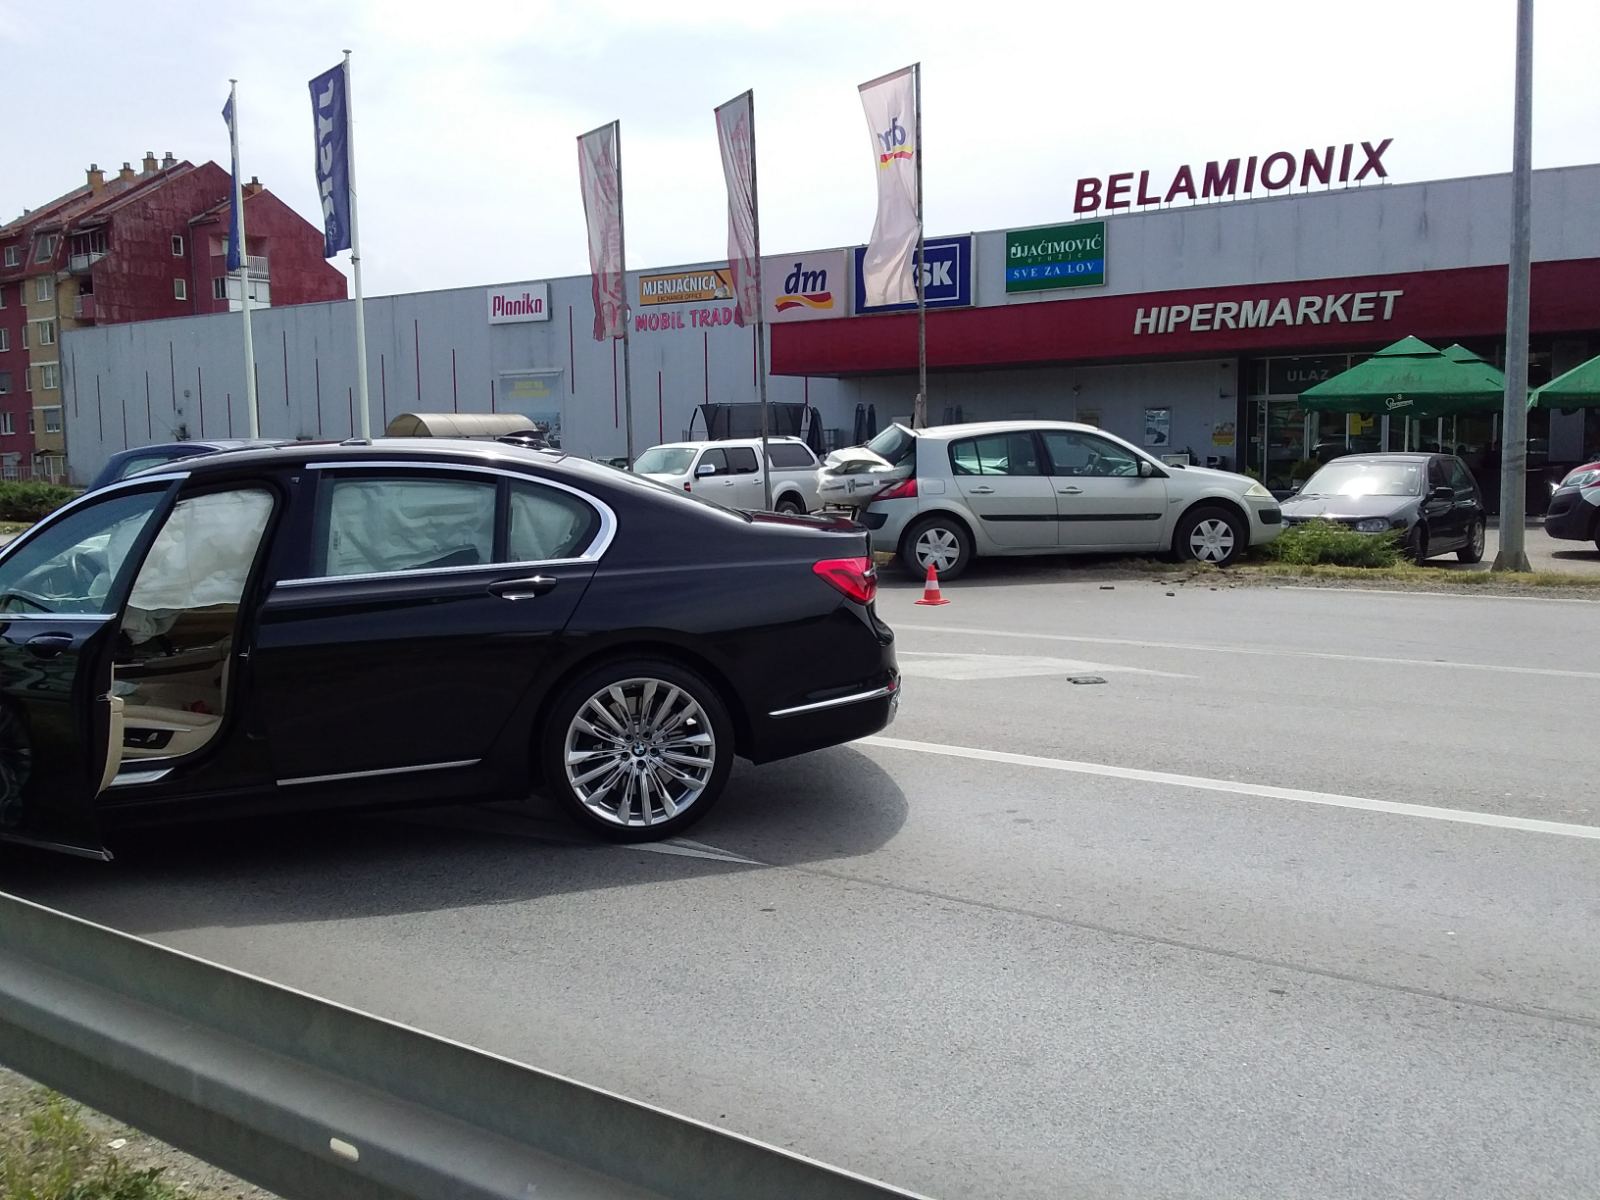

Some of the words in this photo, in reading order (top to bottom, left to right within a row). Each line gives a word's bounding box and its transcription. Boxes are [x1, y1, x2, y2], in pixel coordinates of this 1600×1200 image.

[1073, 138, 1394, 214] BELAMIONIX
[784, 262, 827, 294] dm
[912, 260, 953, 288] SK
[1013, 267, 1038, 280] SVE
[1044, 264, 1060, 276] ZA
[1068, 262, 1095, 274] LOV
[642, 275, 717, 296] MJENJAČNICA
[689, 306, 740, 328] TRAD
[1133, 289, 1404, 335] HIPERMARKET
[1287, 369, 1329, 382] ULAZ
